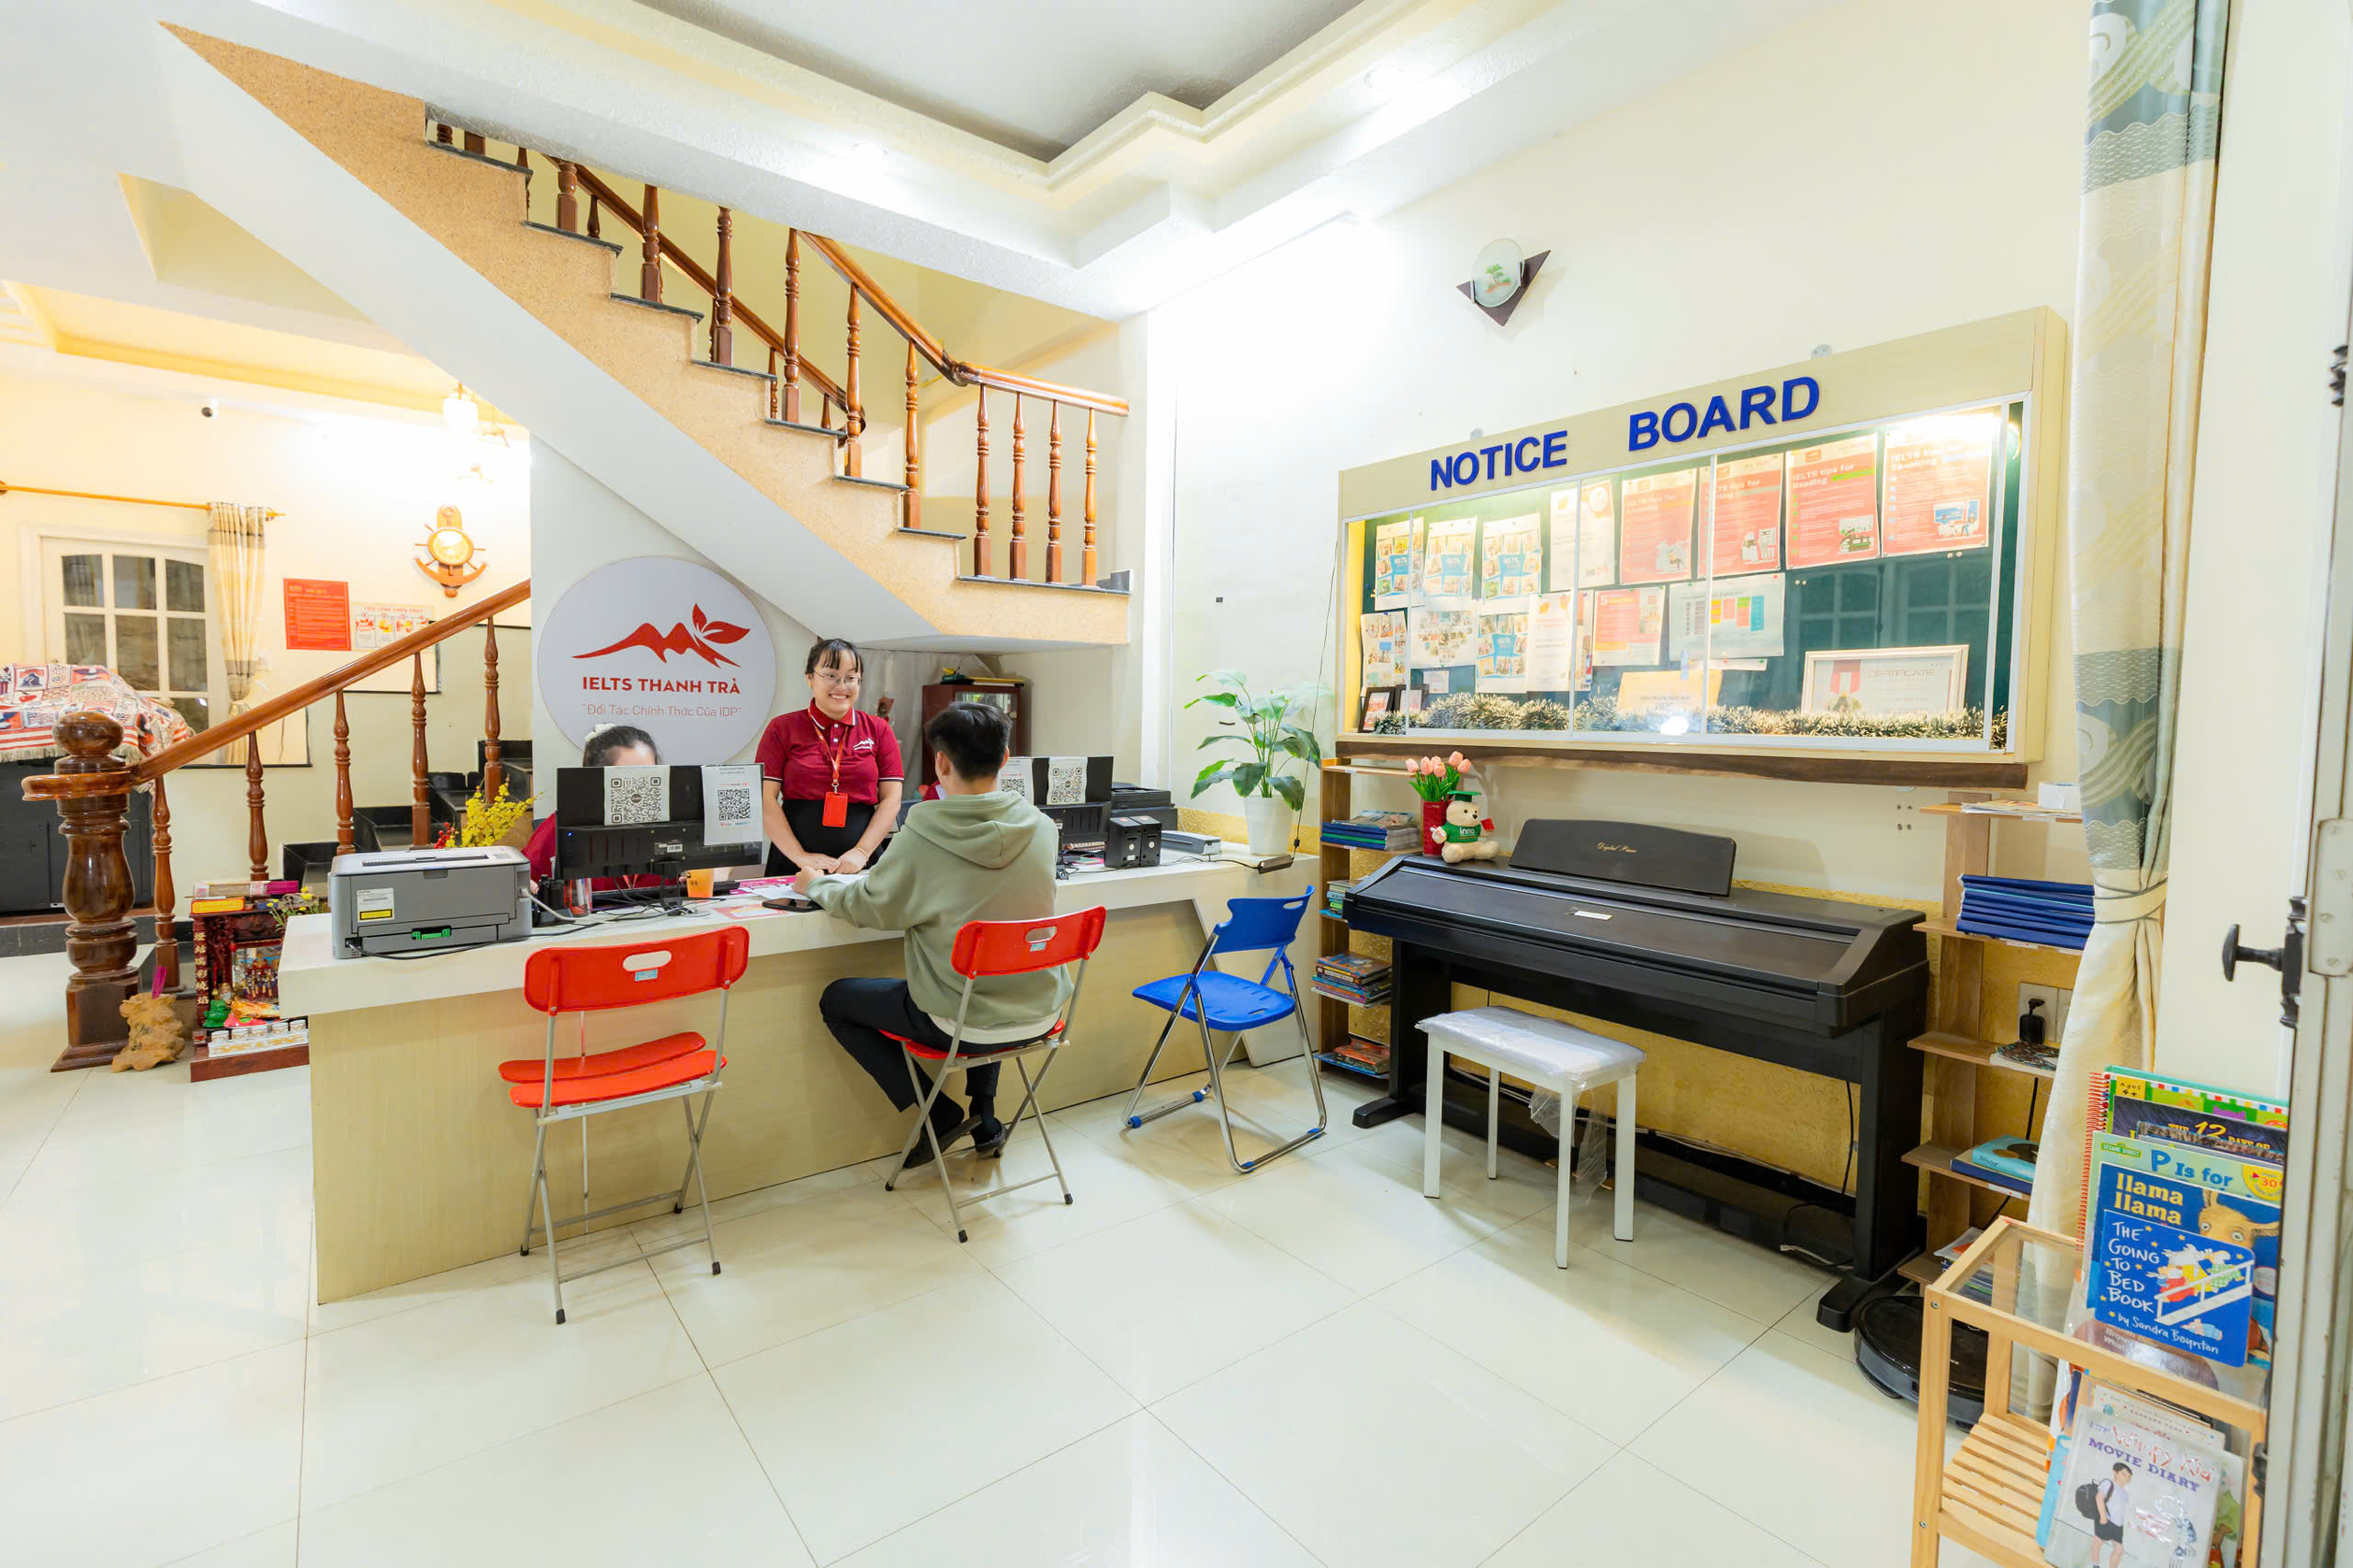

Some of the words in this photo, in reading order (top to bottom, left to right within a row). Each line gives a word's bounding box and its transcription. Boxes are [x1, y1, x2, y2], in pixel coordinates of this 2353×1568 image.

[1431, 430, 1567, 491] NOTICE
[1629, 377, 1820, 452] BOARD
[583, 677, 632, 691] IELTS
[638, 679, 701, 694] THANH
[707, 678, 741, 694] TRÀ
[610, 705, 628, 716] Tác
[632, 705, 664, 716] Chính
[667, 705, 694, 717] Thức
[696, 706, 717, 717] Của
[2194, 1121, 2227, 1138] 12
[2152, 1149, 2171, 1172] P
[2175, 1161, 2195, 1179] Is
[2201, 1168, 2234, 1187] for
[2117, 1172, 2184, 1207] llama
[2260, 1177, 2278, 1189] 30
[2114, 1191, 2182, 1225] llama
[2112, 1221, 2144, 1241] THE
[2108, 1238, 2159, 1264] GOING
[2111, 1258, 2130, 1271] TO
[2108, 1269, 2145, 1292] BED
[2107, 1287, 2155, 1314] BOOK
[2118, 1313, 2129, 1327] by
[2132, 1316, 2169, 1338] Sandra
[2172, 1329, 2220, 1355] Boynton
[2088, 1437, 2143, 1469] MOVIE
[2147, 1462, 2201, 1493] DIARY
